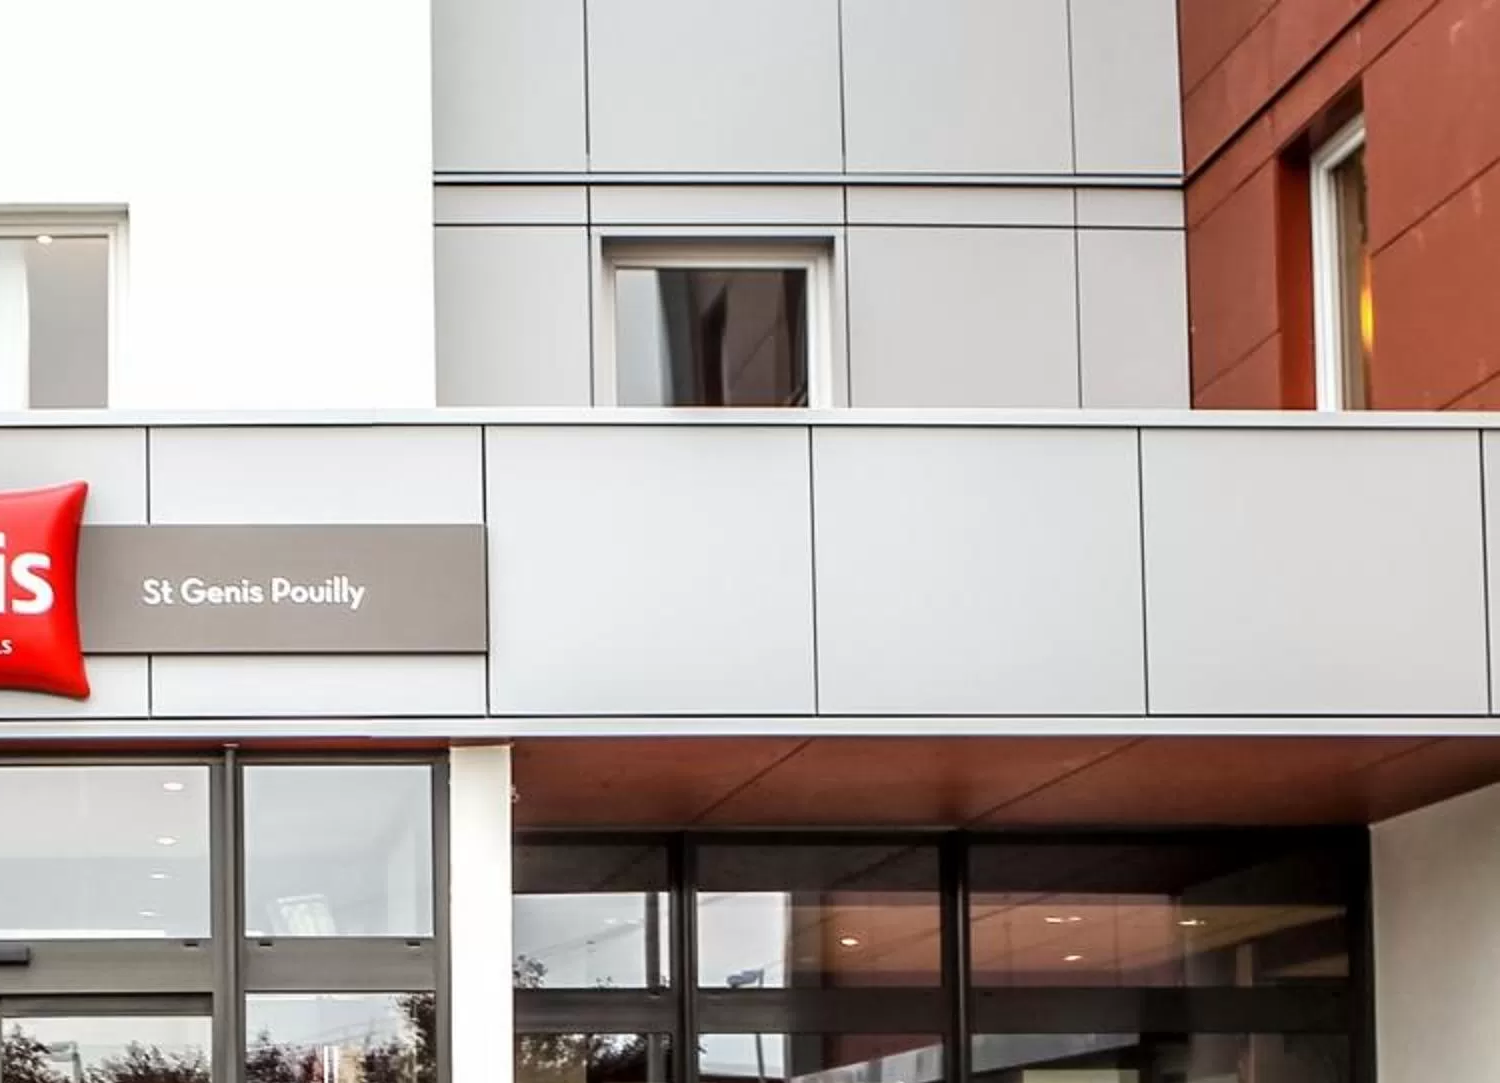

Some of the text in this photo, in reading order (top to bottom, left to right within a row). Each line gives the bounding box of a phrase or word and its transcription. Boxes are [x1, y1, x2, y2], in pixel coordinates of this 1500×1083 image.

[143, 576, 365, 609] St Genis Pouilly
